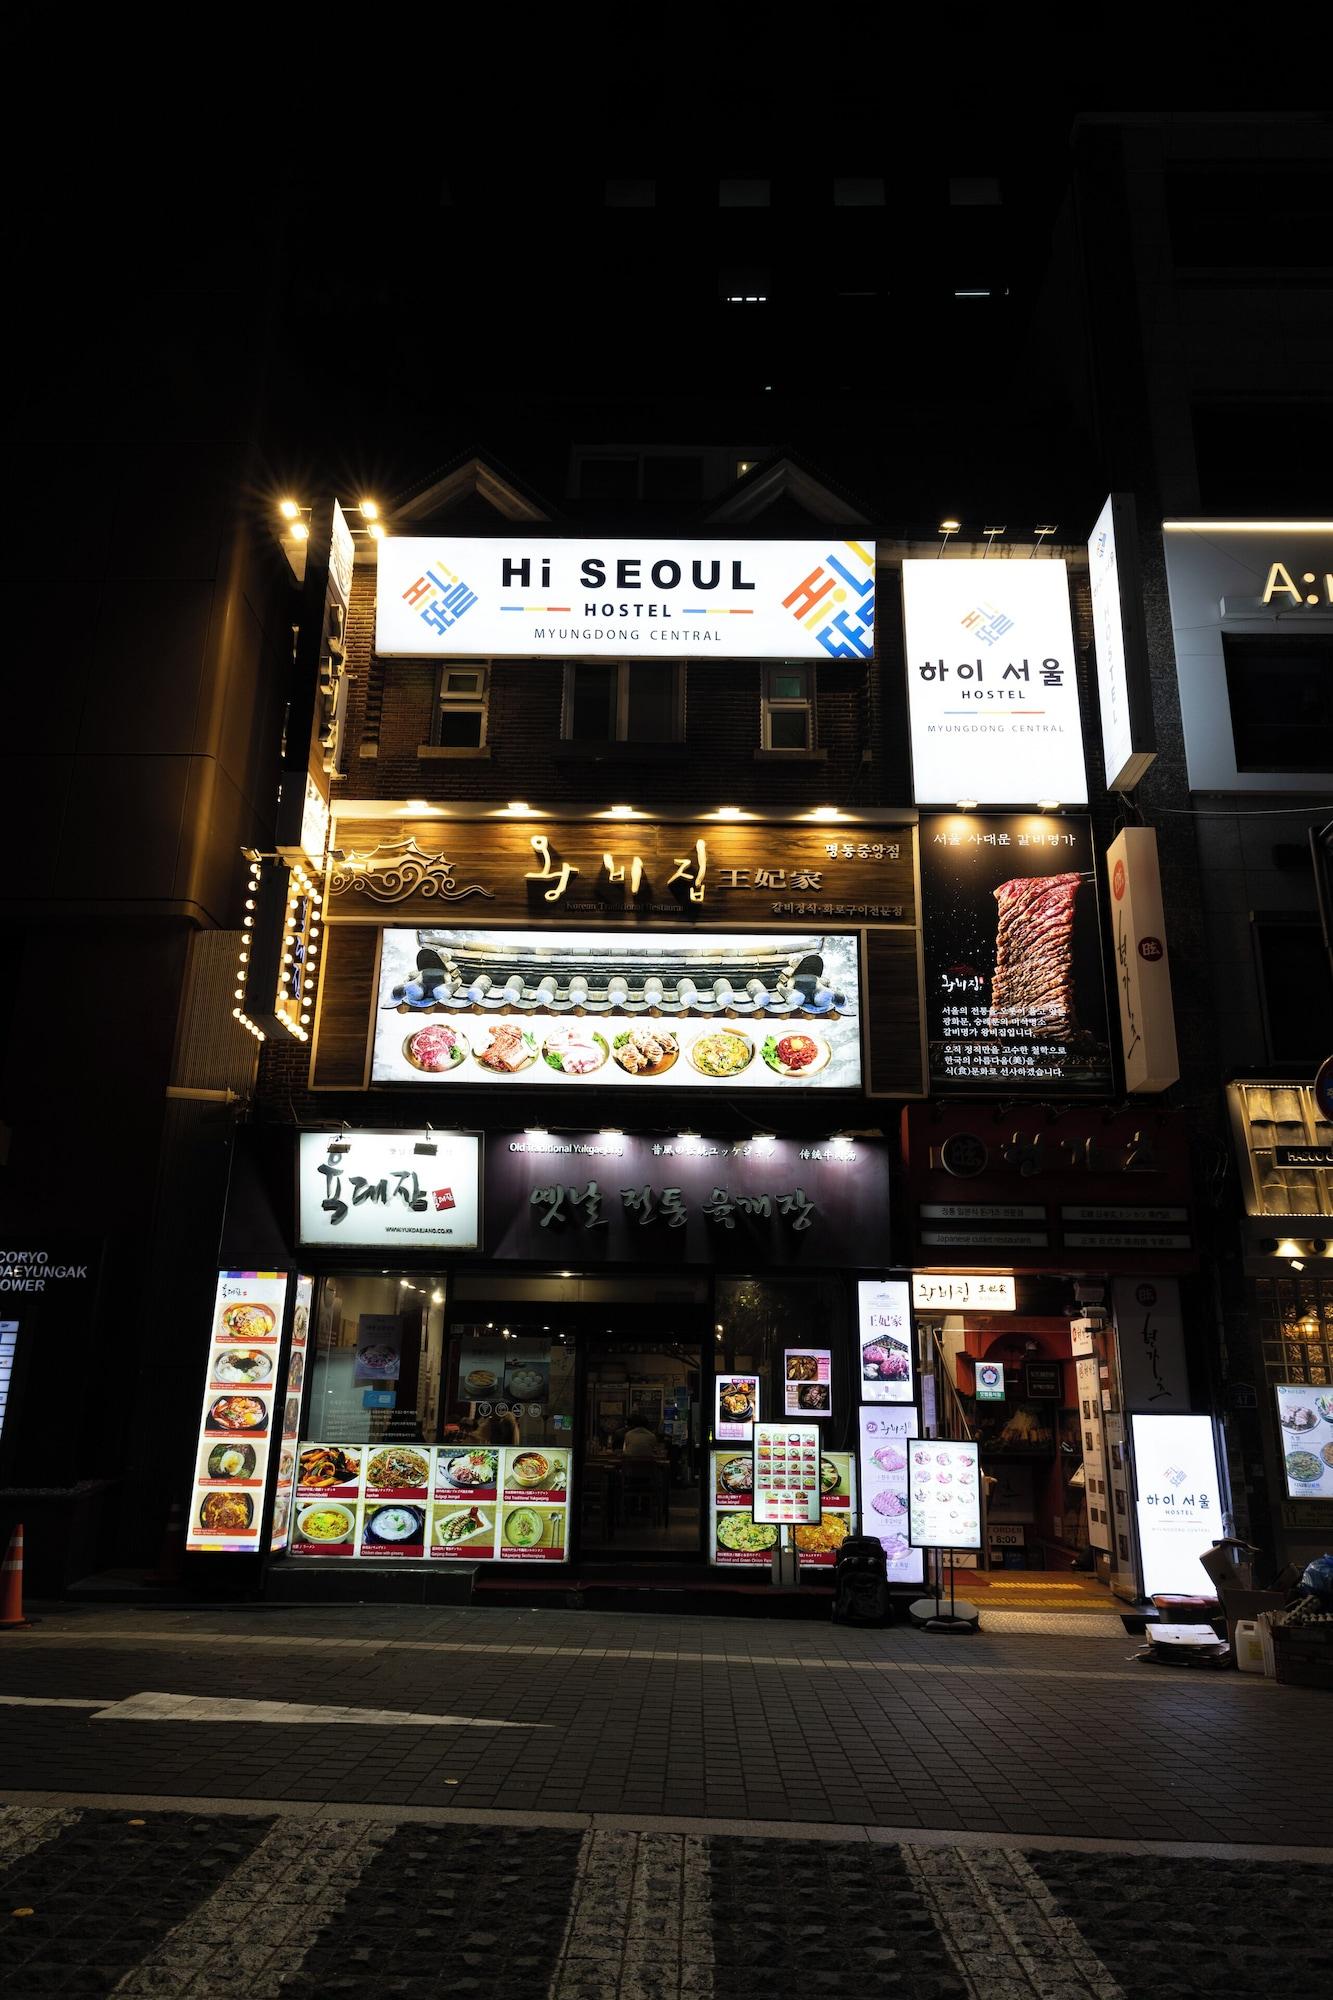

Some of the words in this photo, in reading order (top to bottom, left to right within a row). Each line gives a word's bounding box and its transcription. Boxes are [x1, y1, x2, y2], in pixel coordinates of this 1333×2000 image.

[501, 558, 551, 588] Hi
[580, 559, 755, 591] SEOUL
[584, 603, 671, 618] HOSTEL
[534, 628, 641, 641] MYUNGDONG
[650, 630, 722, 642] CENTRAL
[919, 659, 983, 682] 하이
[1002, 658, 1064, 686] 서울
[962, 690, 1025, 699] HOSTEL
[933, 833, 961, 846] 서울
[967, 833, 1011, 846] 사대문
[1017, 833, 1076, 847] 갈비명가
[824, 843, 901, 860] 명동중앙점
[524, 835, 707, 903] 왕비집
[717, 868, 823, 890] 王妃家
[941, 974, 978, 992] 왕비집
[942, 1006, 968, 1016] 서울의
[943, 1028, 978, 1037] 갈비명가
[980, 1028, 1036, 1038] 왕비집입니다.
[944, 1046, 961, 1055] 오직
[1002, 1046, 1028, 1056] 고수한
[1031, 1046, 1067, 1056] 철학으로
[944, 1056, 970, 1066] 한국의
[1000, 1067, 1064, 1077] 선사하겠습니다.
[509, 1143, 525, 1152] Old
[529, 1180, 608, 1228] 옛날
[620, 1184, 687, 1228] 전통
[919, 1282, 969, 1303] 왕비집
[1146, 1494, 1174, 1506] 하이
[1182, 1494, 1210, 1509] 서울
